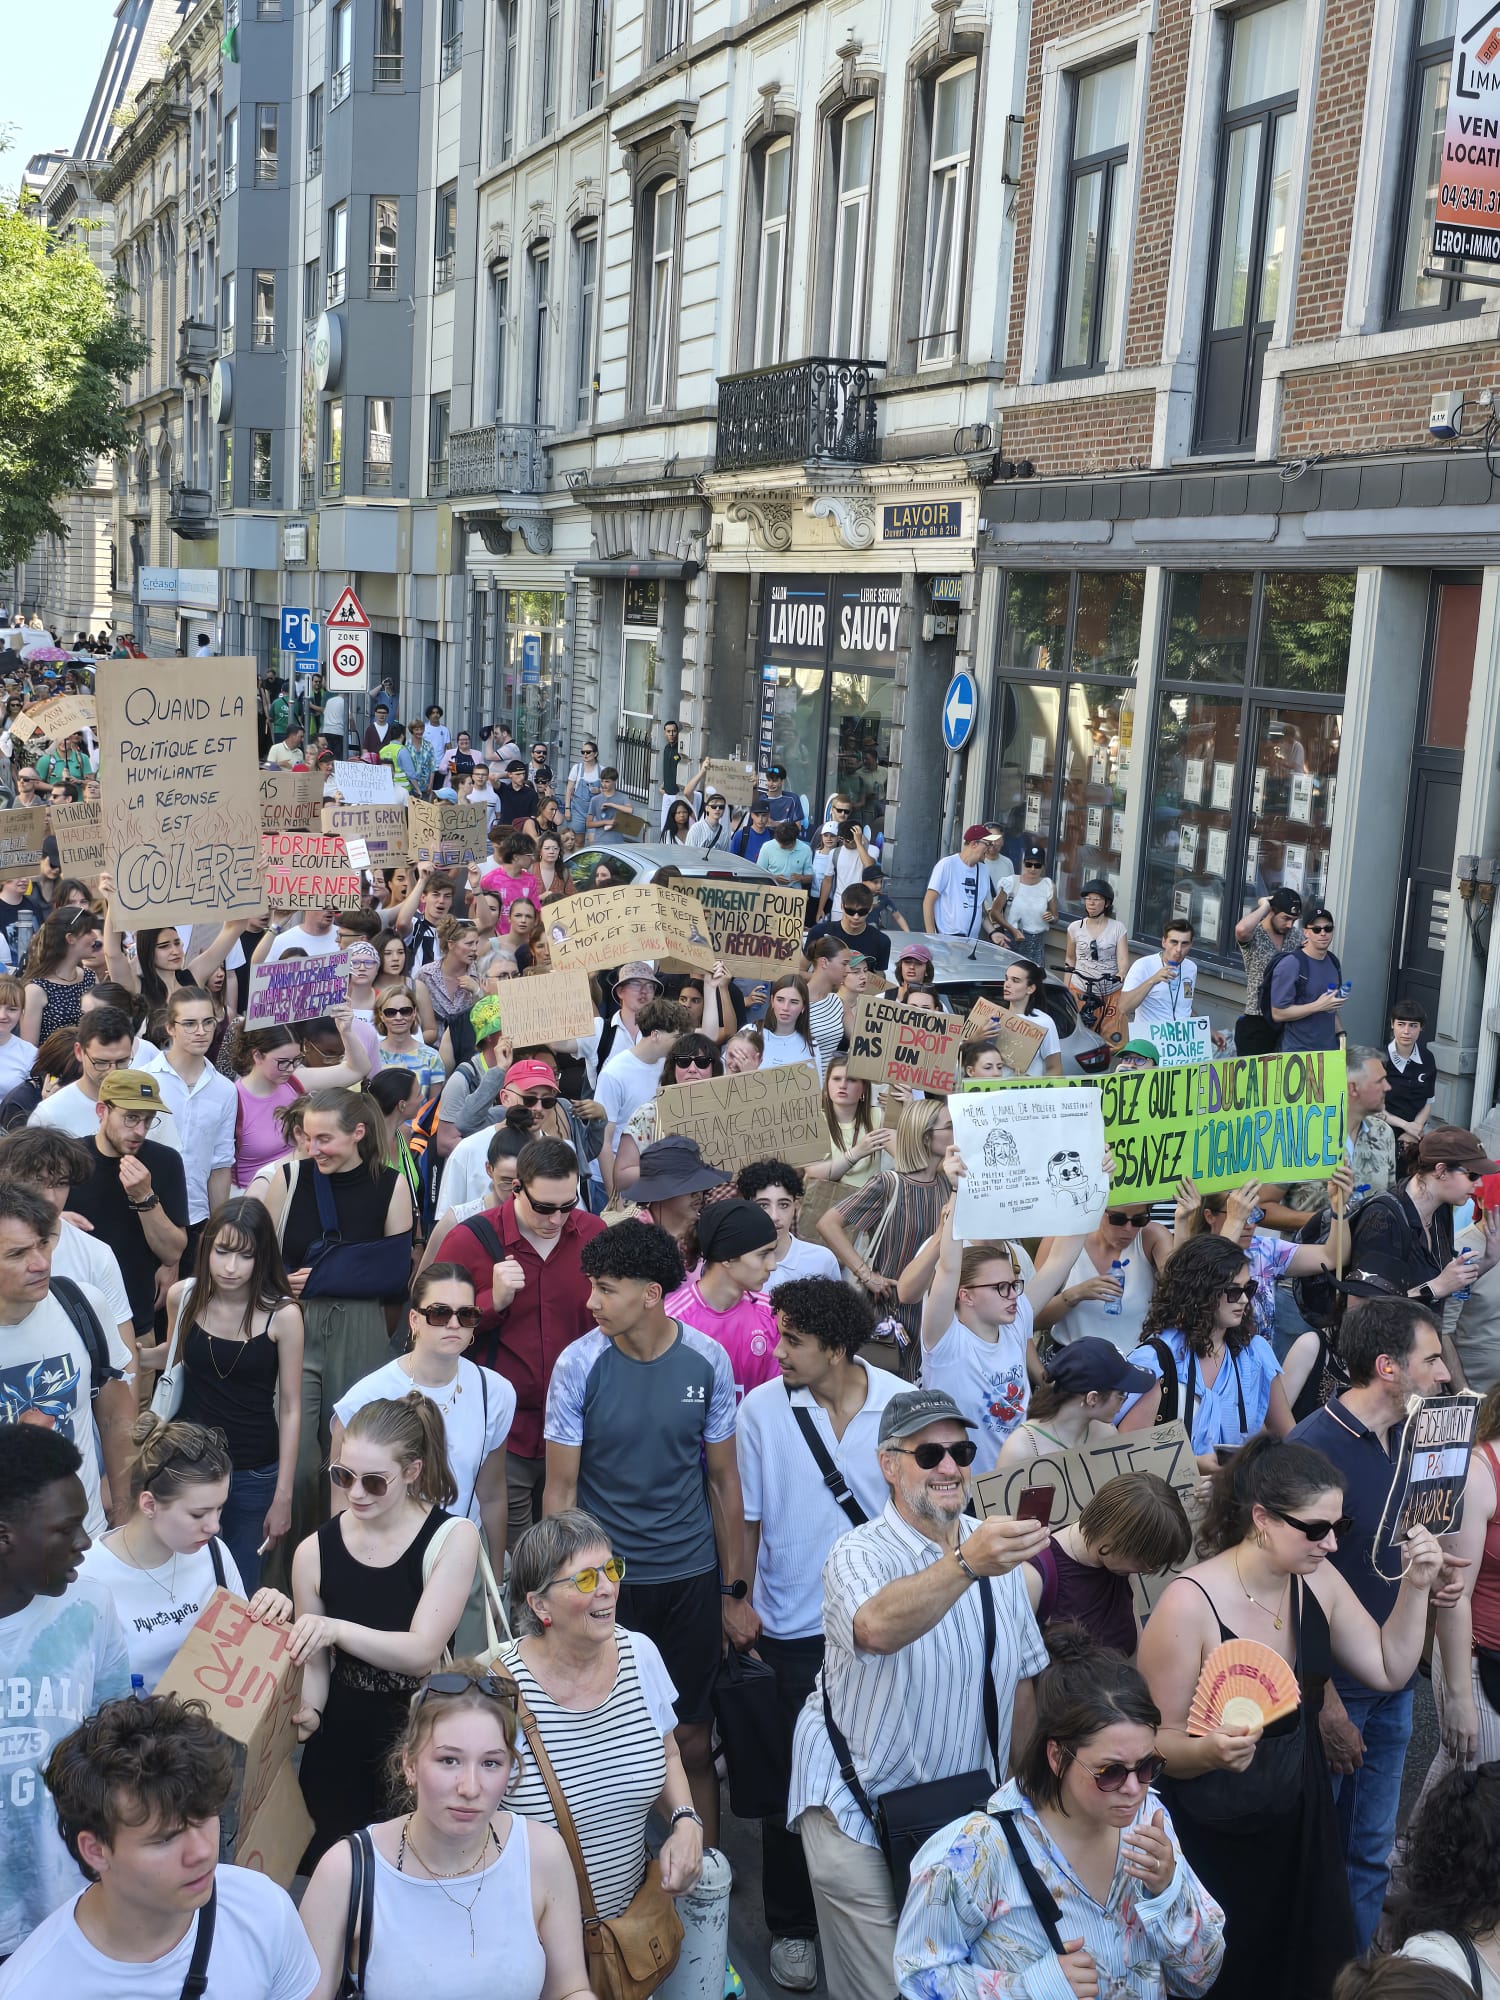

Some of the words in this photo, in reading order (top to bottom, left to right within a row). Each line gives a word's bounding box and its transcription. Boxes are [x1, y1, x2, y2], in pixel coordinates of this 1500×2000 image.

[894, 505, 948, 526] LAVOIR
[920, 527, 927, 536] de
[861, 588, 877, 603] LIBRE
[286, 615, 299, 634] P
[769, 603, 825, 646] LAVOIR
[840, 606, 900, 651] SAUCY
[340, 654, 357, 667] 30
[125, 687, 210, 726] QUAND
[220, 696, 244, 718] LA
[204, 737, 238, 756] EST
[128, 795, 144, 810] LA
[156, 788, 221, 808] RÉPONSE
[161, 815, 193, 833] EST
[332, 811, 369, 827] CETTE
[613, 888, 626, 900] ET
[635, 888, 651, 897] JE
[657, 888, 688, 906] RESTE
[763, 893, 804, 917] POUR
[625, 906, 641, 915] ET
[651, 903, 668, 915] JE
[607, 925, 625, 938] ET
[631, 923, 647, 933] JE
[654, 922, 687, 938] RESTE
[753, 914, 773, 935] DE
[865, 1002, 947, 1035] L'EDUCATION
[866, 1021, 883, 1034] UN
[899, 1026, 953, 1054] DROIT
[1150, 1021, 1196, 1042] PARENT
[852, 1036, 882, 1058] PAS
[894, 1045, 920, 1065] UN
[669, 1082, 710, 1118] JE
[710, 1072, 768, 1110] VAIS
[775, 1065, 812, 1095] PAS
[1149, 1070, 1181, 1120] QUE
[712, 1110, 745, 1137] AVEC
[782, 1121, 819, 1144] MON
